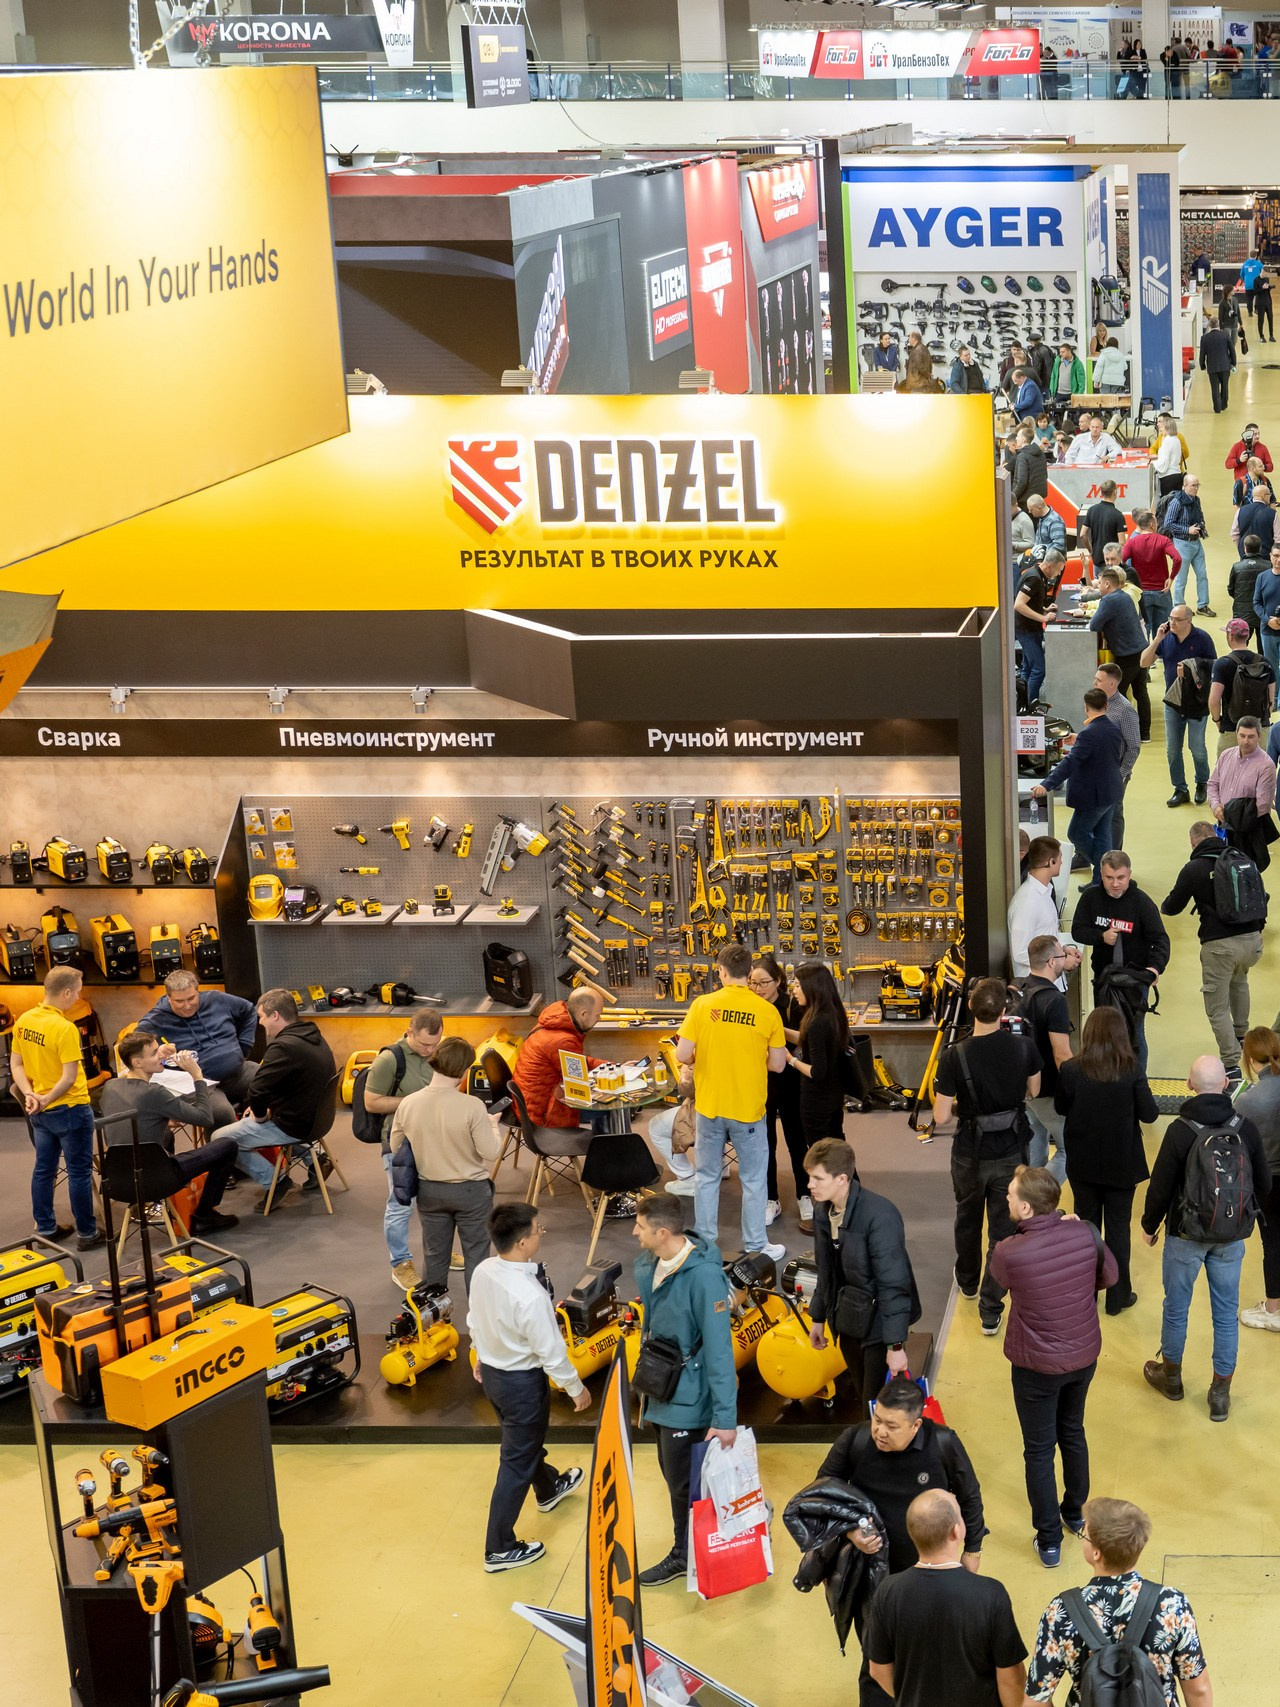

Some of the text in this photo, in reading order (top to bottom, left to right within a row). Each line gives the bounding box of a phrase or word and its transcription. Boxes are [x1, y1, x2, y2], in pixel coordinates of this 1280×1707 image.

[220, 21, 331, 42] KORONA
[385, 33, 412, 47] KORONA
[892, 53, 949, 68] УралБензоТех
[1181, 211, 1240, 219] METALLICA
[868, 206, 1064, 248] AYGER
[3, 238, 279, 338] World In Your Hands
[650, 264, 688, 309] ELITECH
[654, 316, 666, 336] HD
[533, 440, 776, 523] DENZEL
[458, 550, 779, 568] РЕЗУЛЬТАТ В ТВОИХ РУКАХ
[37, 727, 122, 751] Сварка
[278, 727, 496, 752] Пневмоинструмент
[647, 727, 865, 753] Ручной инструмент
[722, 1010, 756, 1027] DENZEL
[23, 1028, 46, 1047] DENZEL
[11, 1292, 28, 1304] DENZEL
[595, 1333, 618, 1354] DENZEL
[599, 1565, 609, 1615] World
[603, 1619, 610, 1635] In
[603, 1638, 611, 1679] Your
